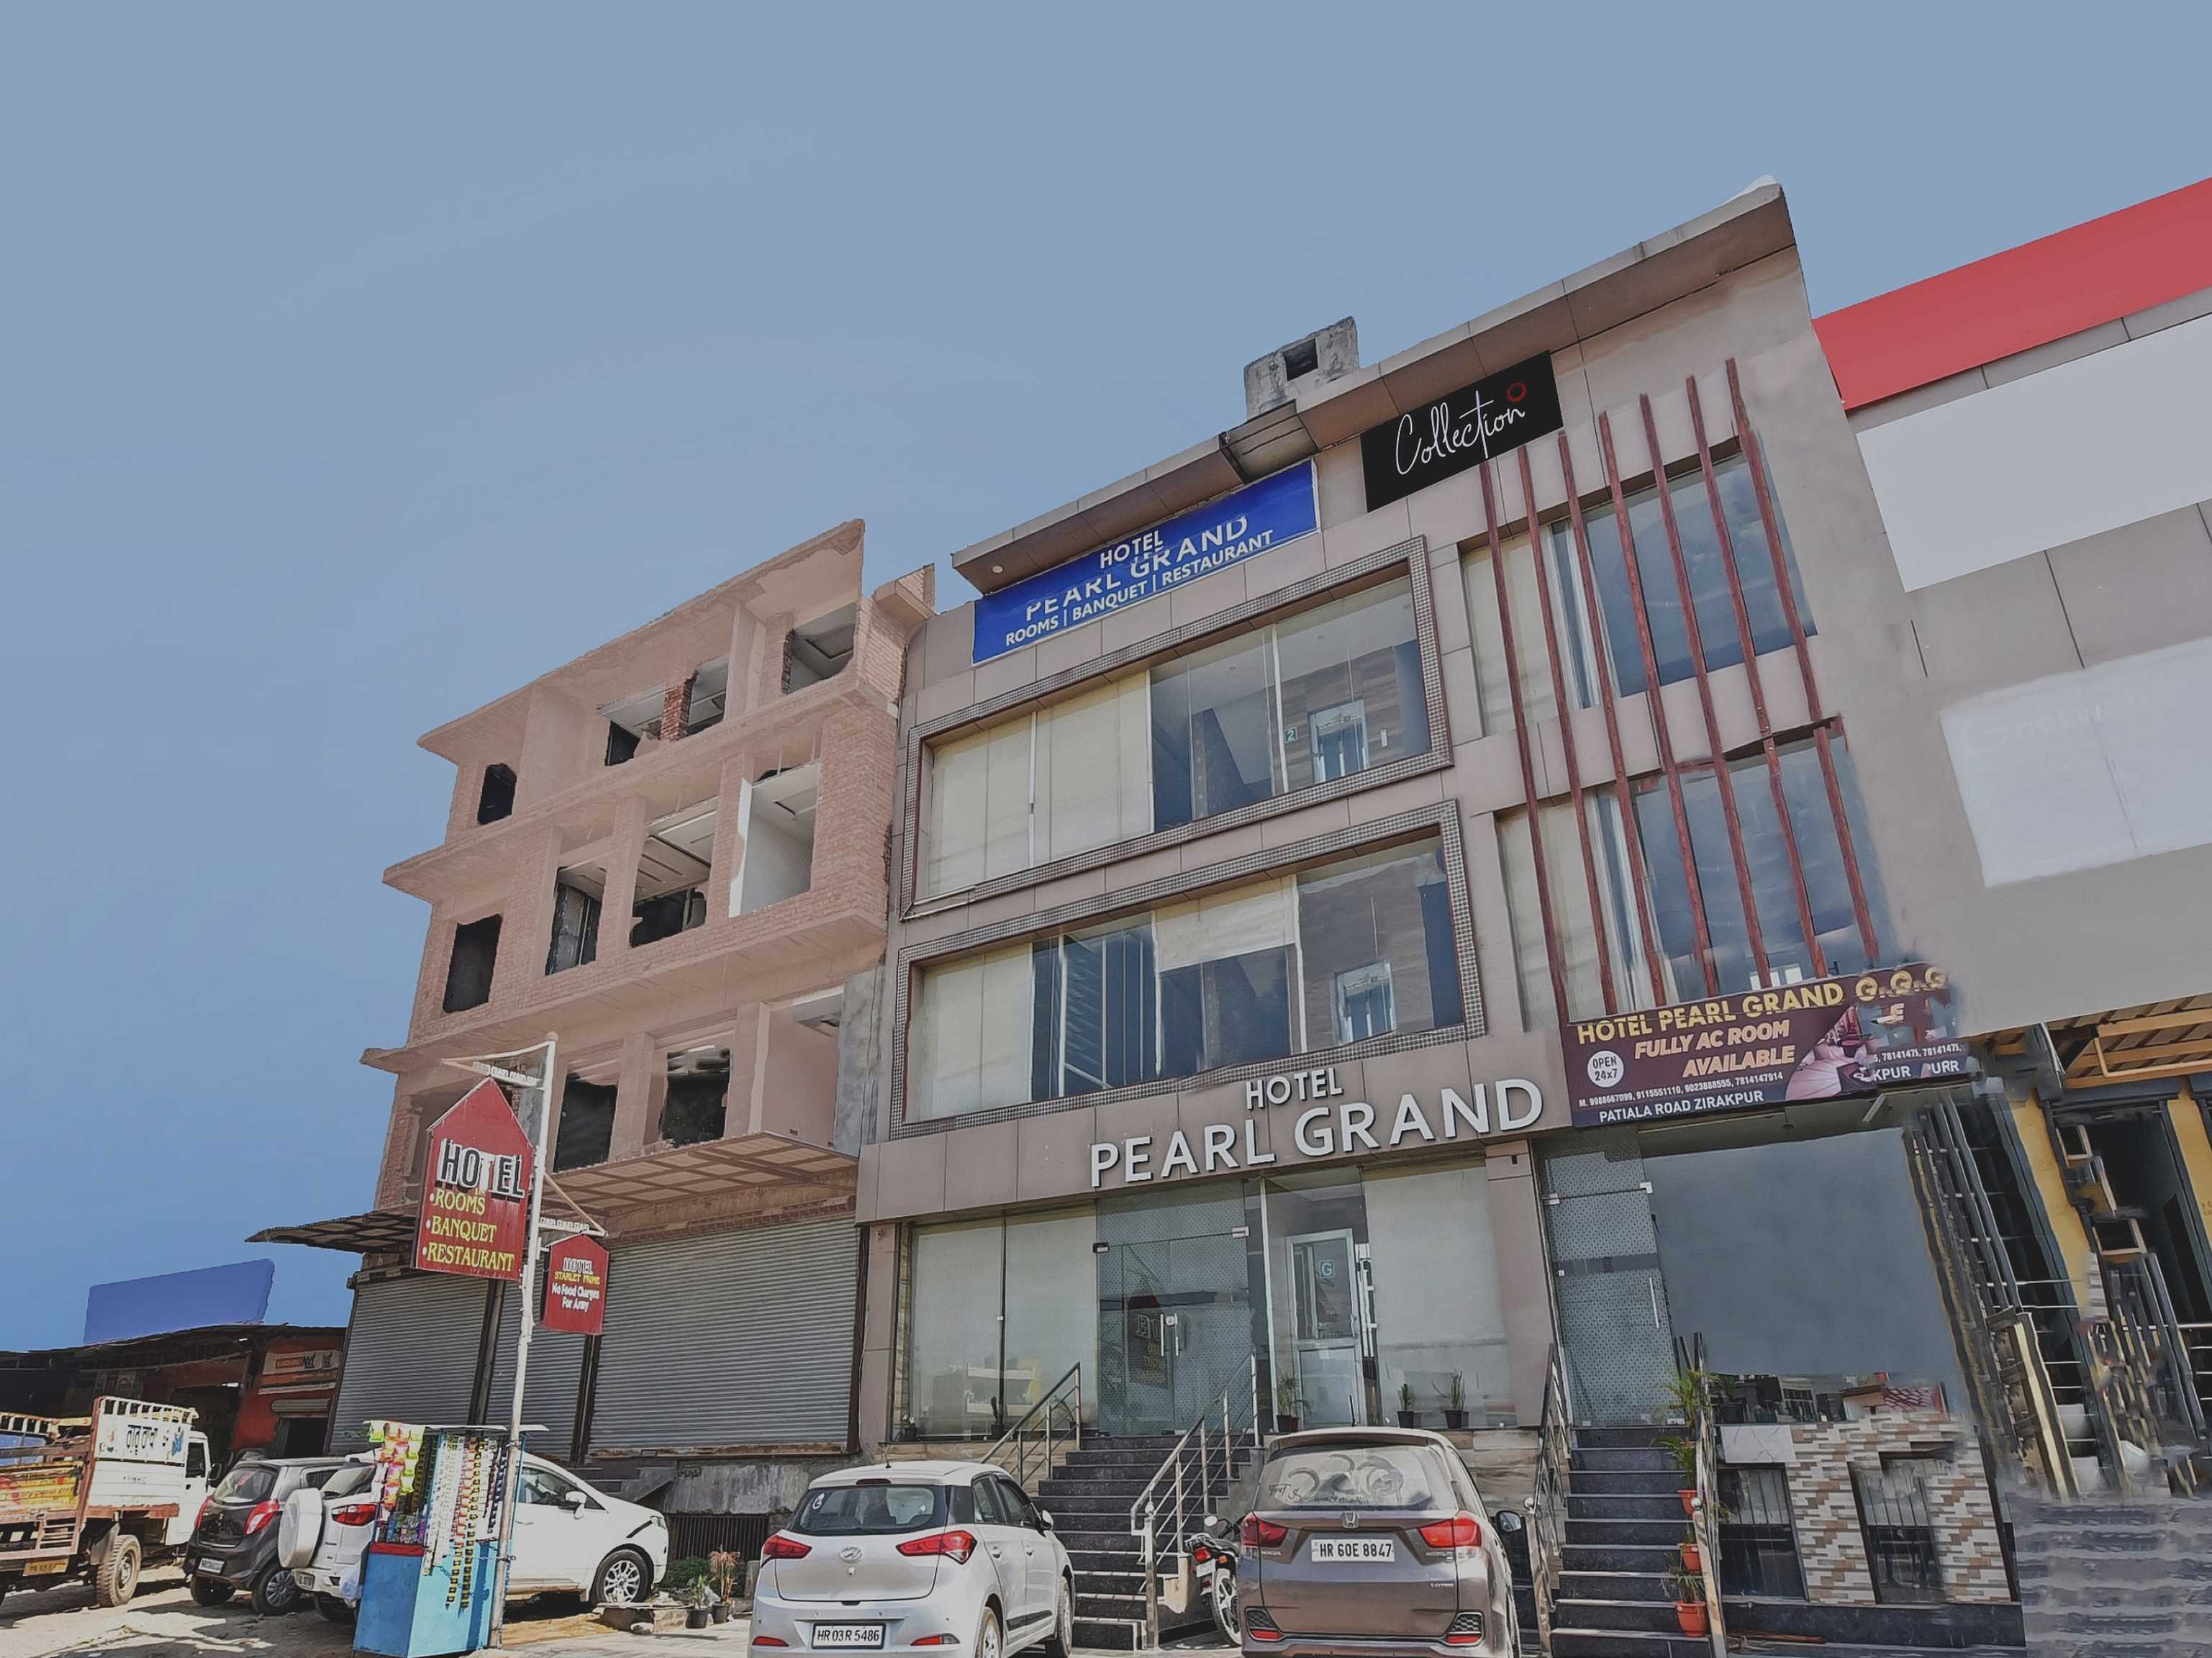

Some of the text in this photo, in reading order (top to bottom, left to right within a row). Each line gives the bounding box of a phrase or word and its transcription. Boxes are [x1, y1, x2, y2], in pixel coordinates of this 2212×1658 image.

[1395, 389, 1526, 475] Collection
[1100, 530, 1164, 568] HOTEL
[1025, 515, 1249, 621] PEARL GRAND
[1005, 529, 1274, 646] ROOMS BANQUET RESTAURANT
[1285, 729, 1295, 741] 2
[1577, 1014, 1652, 1045] HOTEL
[1658, 1000, 1736, 1031] PEARL
[1742, 982, 1844, 1018] GRAND
[1634, 1020, 1790, 1059] FULLY AC ROOM
[1592, 1056, 1617, 1069] OPEN
[1595, 1069, 1618, 1081] 24x7
[1682, 1045, 1795, 1078] AVAILABLE
[1246, 1067, 1343, 1110] HOTEL
[1599, 1090, 1764, 1123] PATIALA ROAD ZIRAKPUR
[1091, 1078, 1544, 1187] PEARL GRAND
[436, 1138, 525, 1199] HOTEL
[433, 1188, 486, 1216] ROOMS
[430, 1215, 497, 1244] BANQUET
[427, 1242, 515, 1272] RESTAURANT
[1321, 1261, 1333, 1277] G
[554, 1271, 581, 1282] STARLET
[561, 1284, 577, 1297] Food
[577, 1286, 600, 1301] Charges
[1320, 1543, 1334, 1558] HR
[1362, 1542, 1392, 1558] 8847
[817, 1629, 831, 1641] HR
[853, 1629, 880, 1641] 5486
